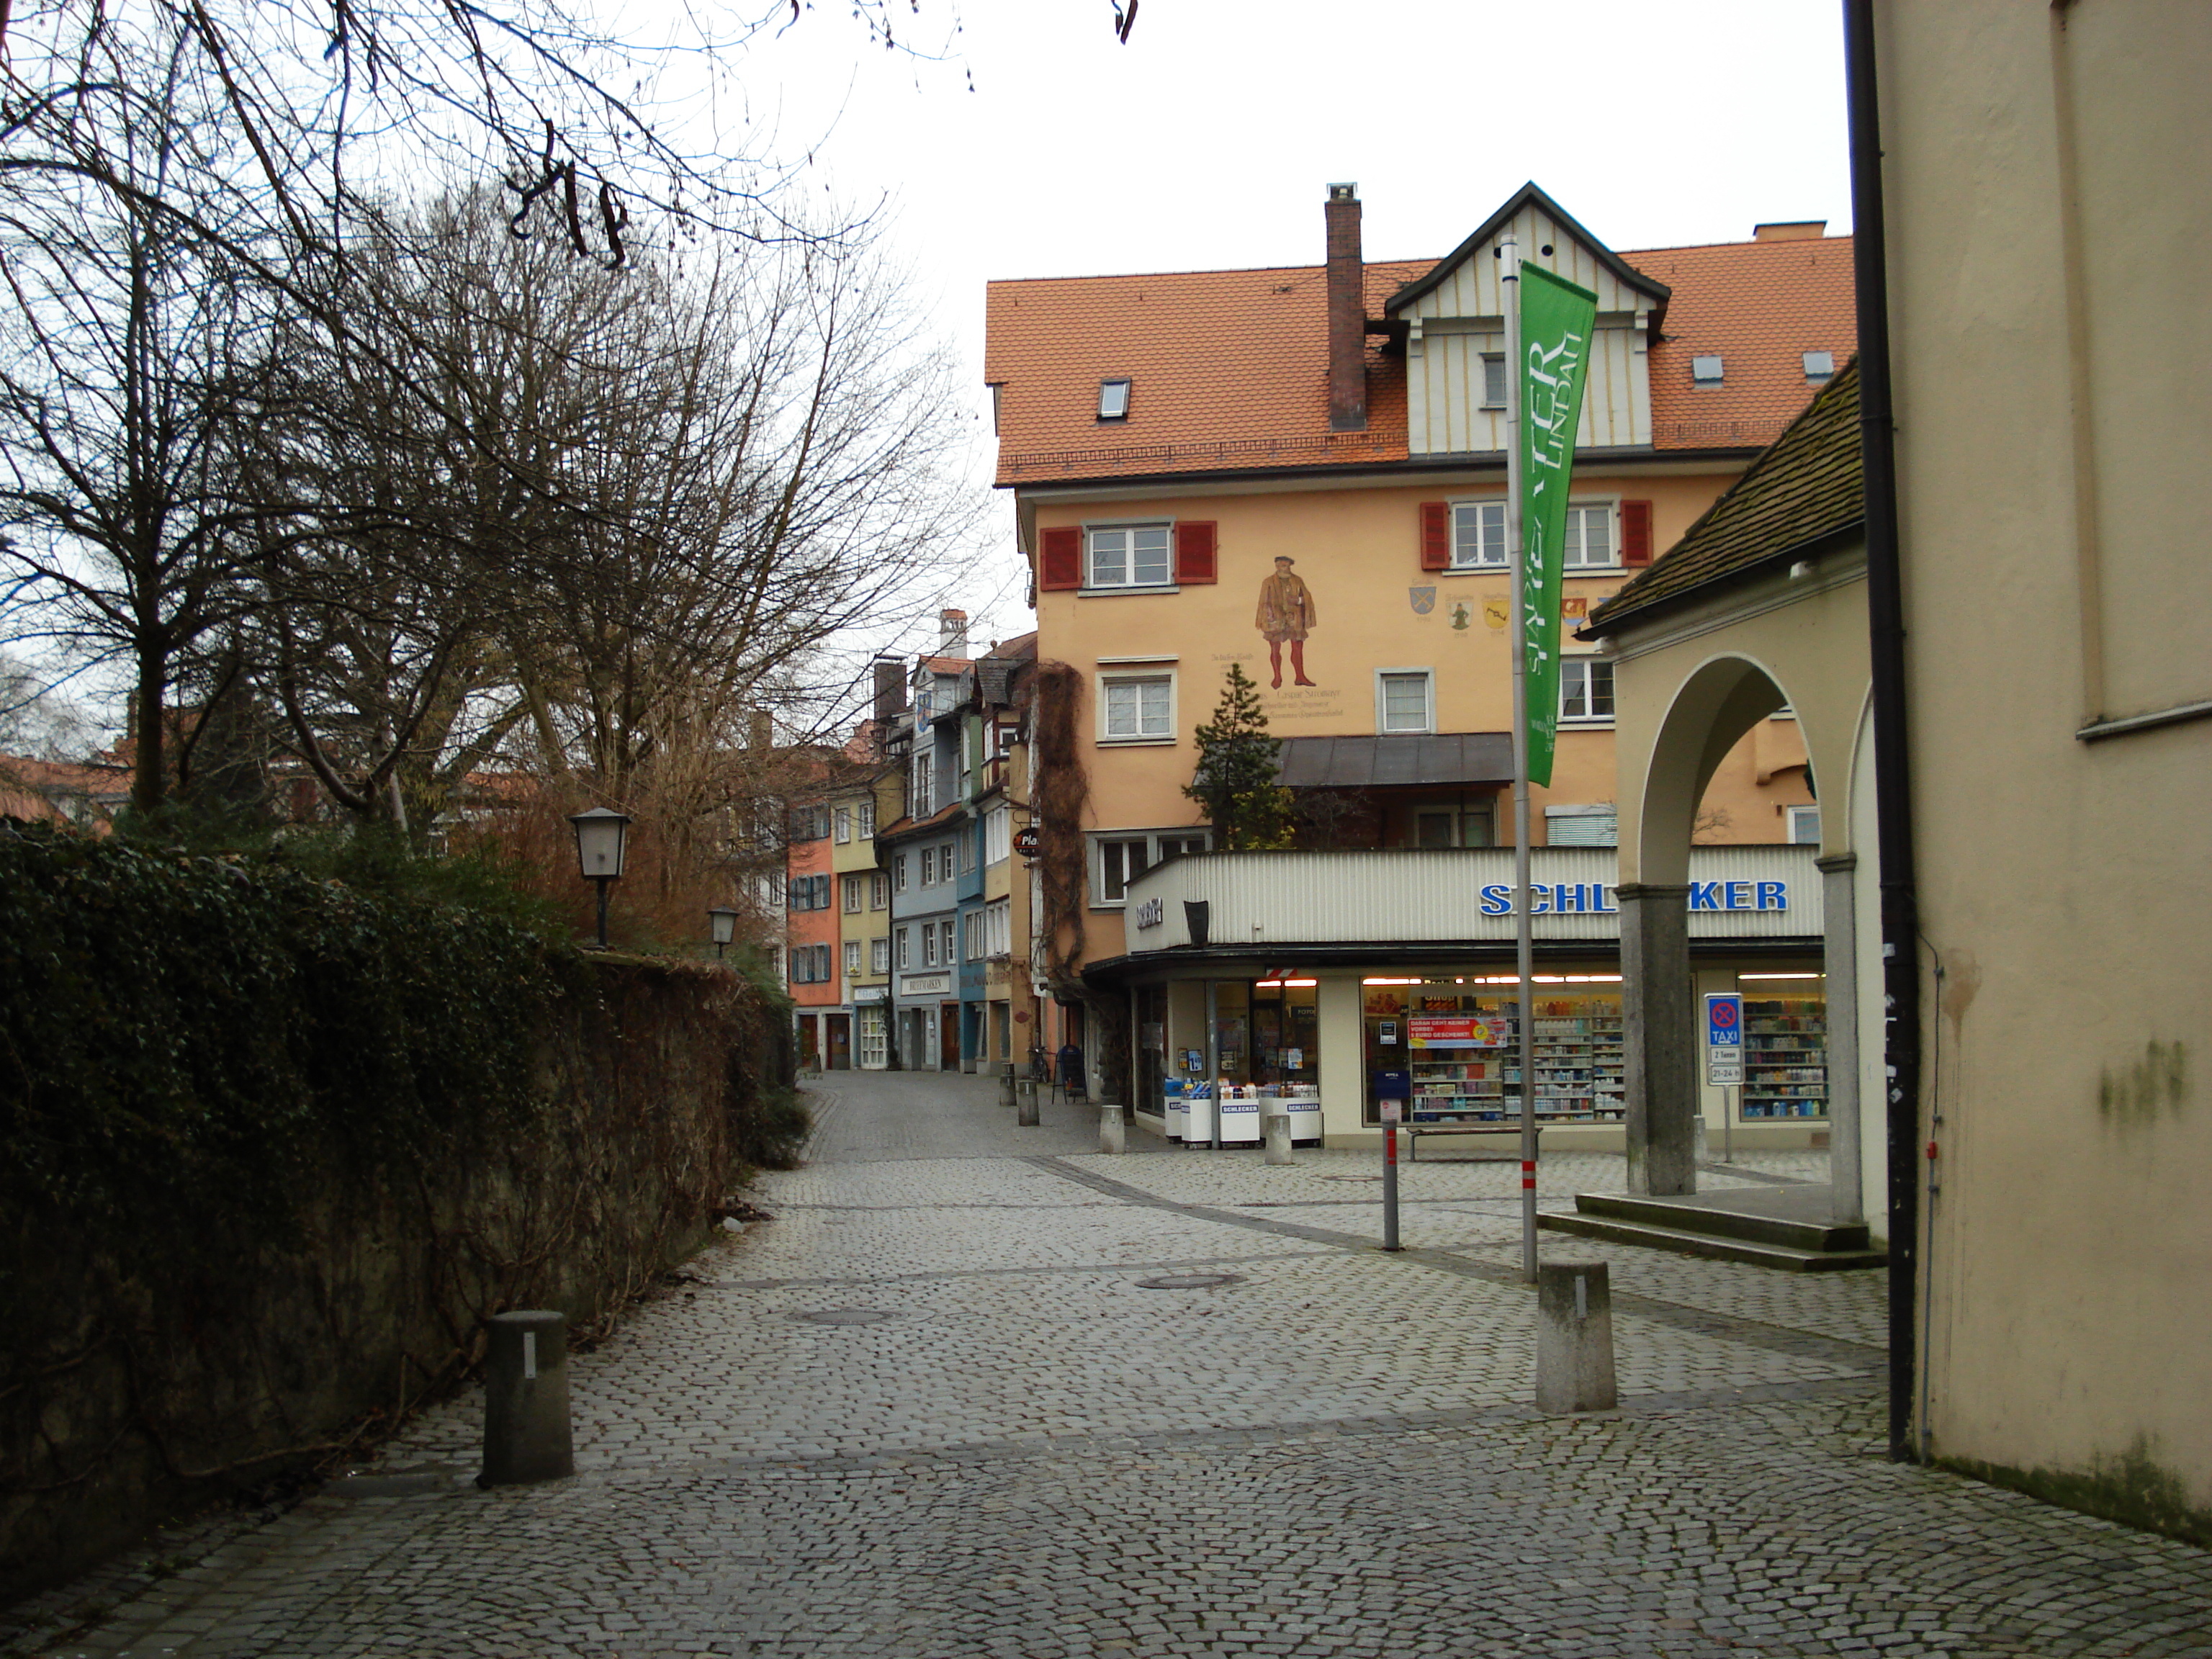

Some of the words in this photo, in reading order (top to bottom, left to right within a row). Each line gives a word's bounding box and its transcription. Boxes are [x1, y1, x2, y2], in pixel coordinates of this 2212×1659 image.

[1546, 333, 1582, 469] LINDAU
[1022, 835, 1039, 845] Pla
[1480, 880, 1788, 916] SCHLKER
[1712, 1031, 1737, 1041] TAXI
